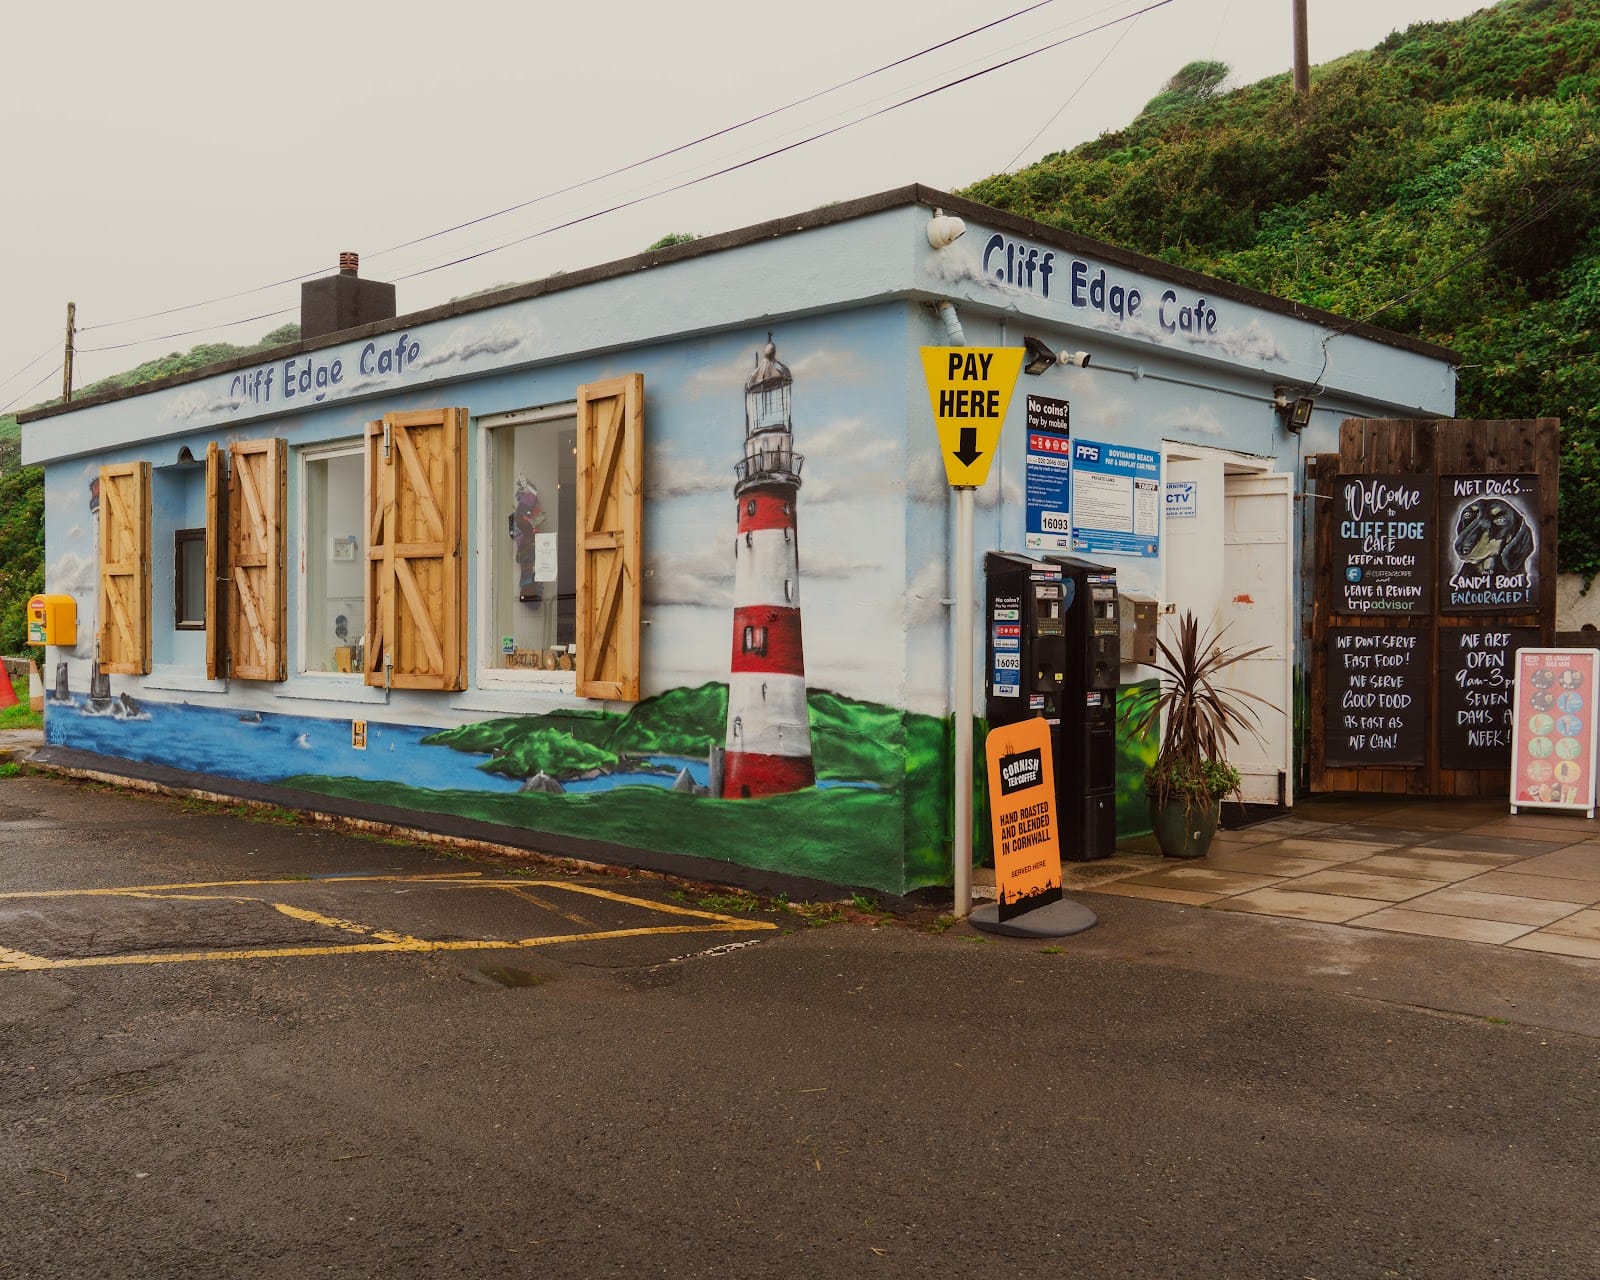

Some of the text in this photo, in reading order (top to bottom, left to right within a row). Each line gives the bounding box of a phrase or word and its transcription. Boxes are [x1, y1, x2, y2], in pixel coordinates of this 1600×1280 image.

[983, 235, 1217, 335] Cliff Edge Cafe
[230, 333, 421, 410] Cliff Edge Cafe
[948, 353, 993, 380] PAY
[939, 390, 1000, 418] HERE
[1028, 400, 1068, 417] No coins?
[1029, 414, 1068, 429] Pay by mobile
[1076, 445, 1099, 461] PPS
[1453, 479, 1482, 497] WET
[1387, 508, 1397, 517] to
[1043, 518, 1068, 530] 16093
[1341, 521, 1425, 540] CLIFF EDGE
[1363, 535, 1397, 553] CAFE
[1348, 554, 1373, 566] KEEP
[1385, 554, 1415, 566] TOUCH
[1449, 573, 1532, 591] SANDY BOOTS
[1344, 585, 1374, 597] LEAVE
[1376, 585, 1383, 597] A
[1348, 597, 1415, 612] tripadvisor
[1337, 636, 1352, 648] WE
[1382, 635, 1417, 648] SERVE
[1460, 632, 1511, 649] WE ARE
[997, 658, 1019, 668] 16093
[1344, 653, 1372, 669] FAST
[1467, 650, 1505, 669] OPEN
[1350, 675, 1404, 689] WE SERVE
[1455, 668, 1515, 689] 9am-3p
[1342, 690, 1412, 709] GOOD FOOD
[1465, 690, 1508, 706] SEVEN
[1344, 715, 1404, 729] AS FAST AS
[1457, 708, 1513, 725] DAYS A
[1349, 734, 1366, 750] WE
[1002, 758, 1039, 780] CORNISH
[1000, 801, 1049, 827] HAND ROASTED
[1001, 814, 1050, 841] AND BLENDED
[1002, 828, 1051, 856] IN CORNWALL
[1011, 860, 1047, 878] SERVED HERE
